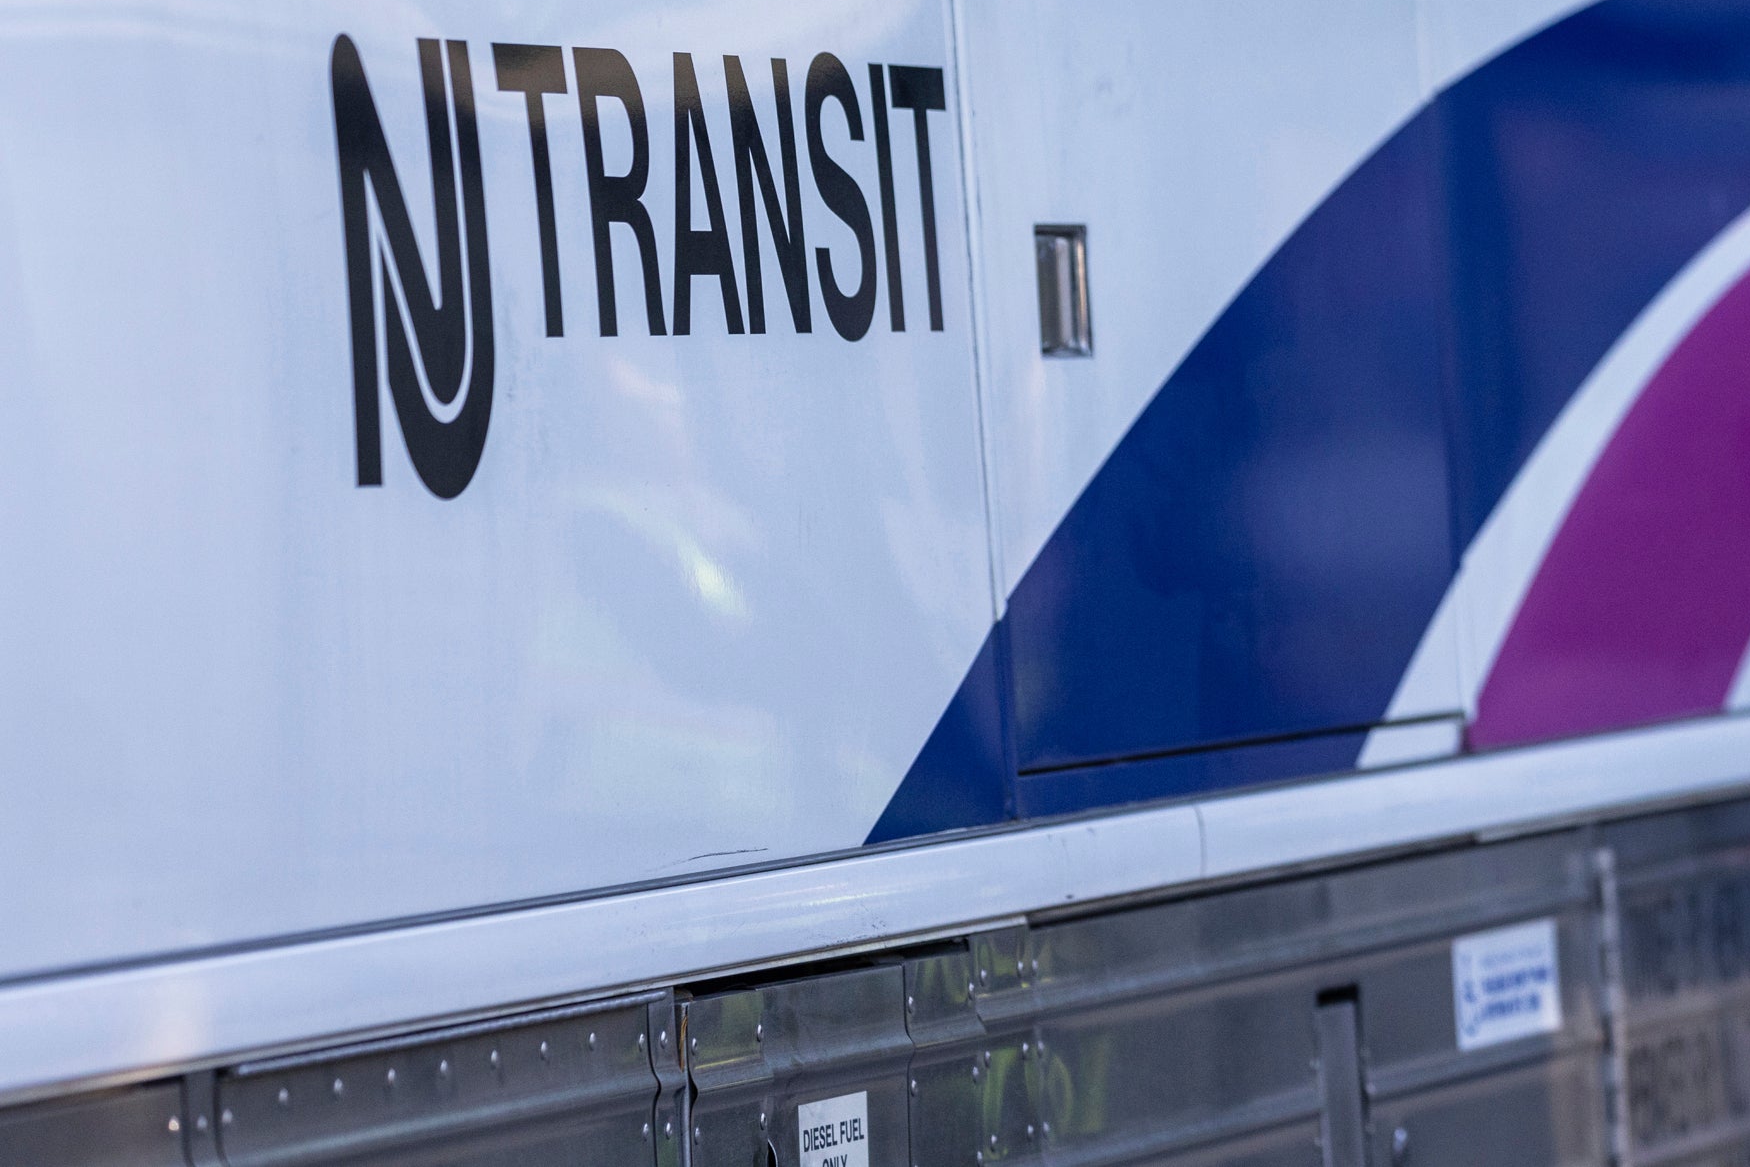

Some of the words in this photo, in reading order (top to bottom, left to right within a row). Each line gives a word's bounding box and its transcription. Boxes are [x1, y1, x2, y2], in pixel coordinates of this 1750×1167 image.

[331, 32, 495, 500] NJ
[490, 41, 947, 343] TRANSIT
[803, 1123, 838, 1153] DIESEL
[839, 1117, 865, 1145] FUEL
